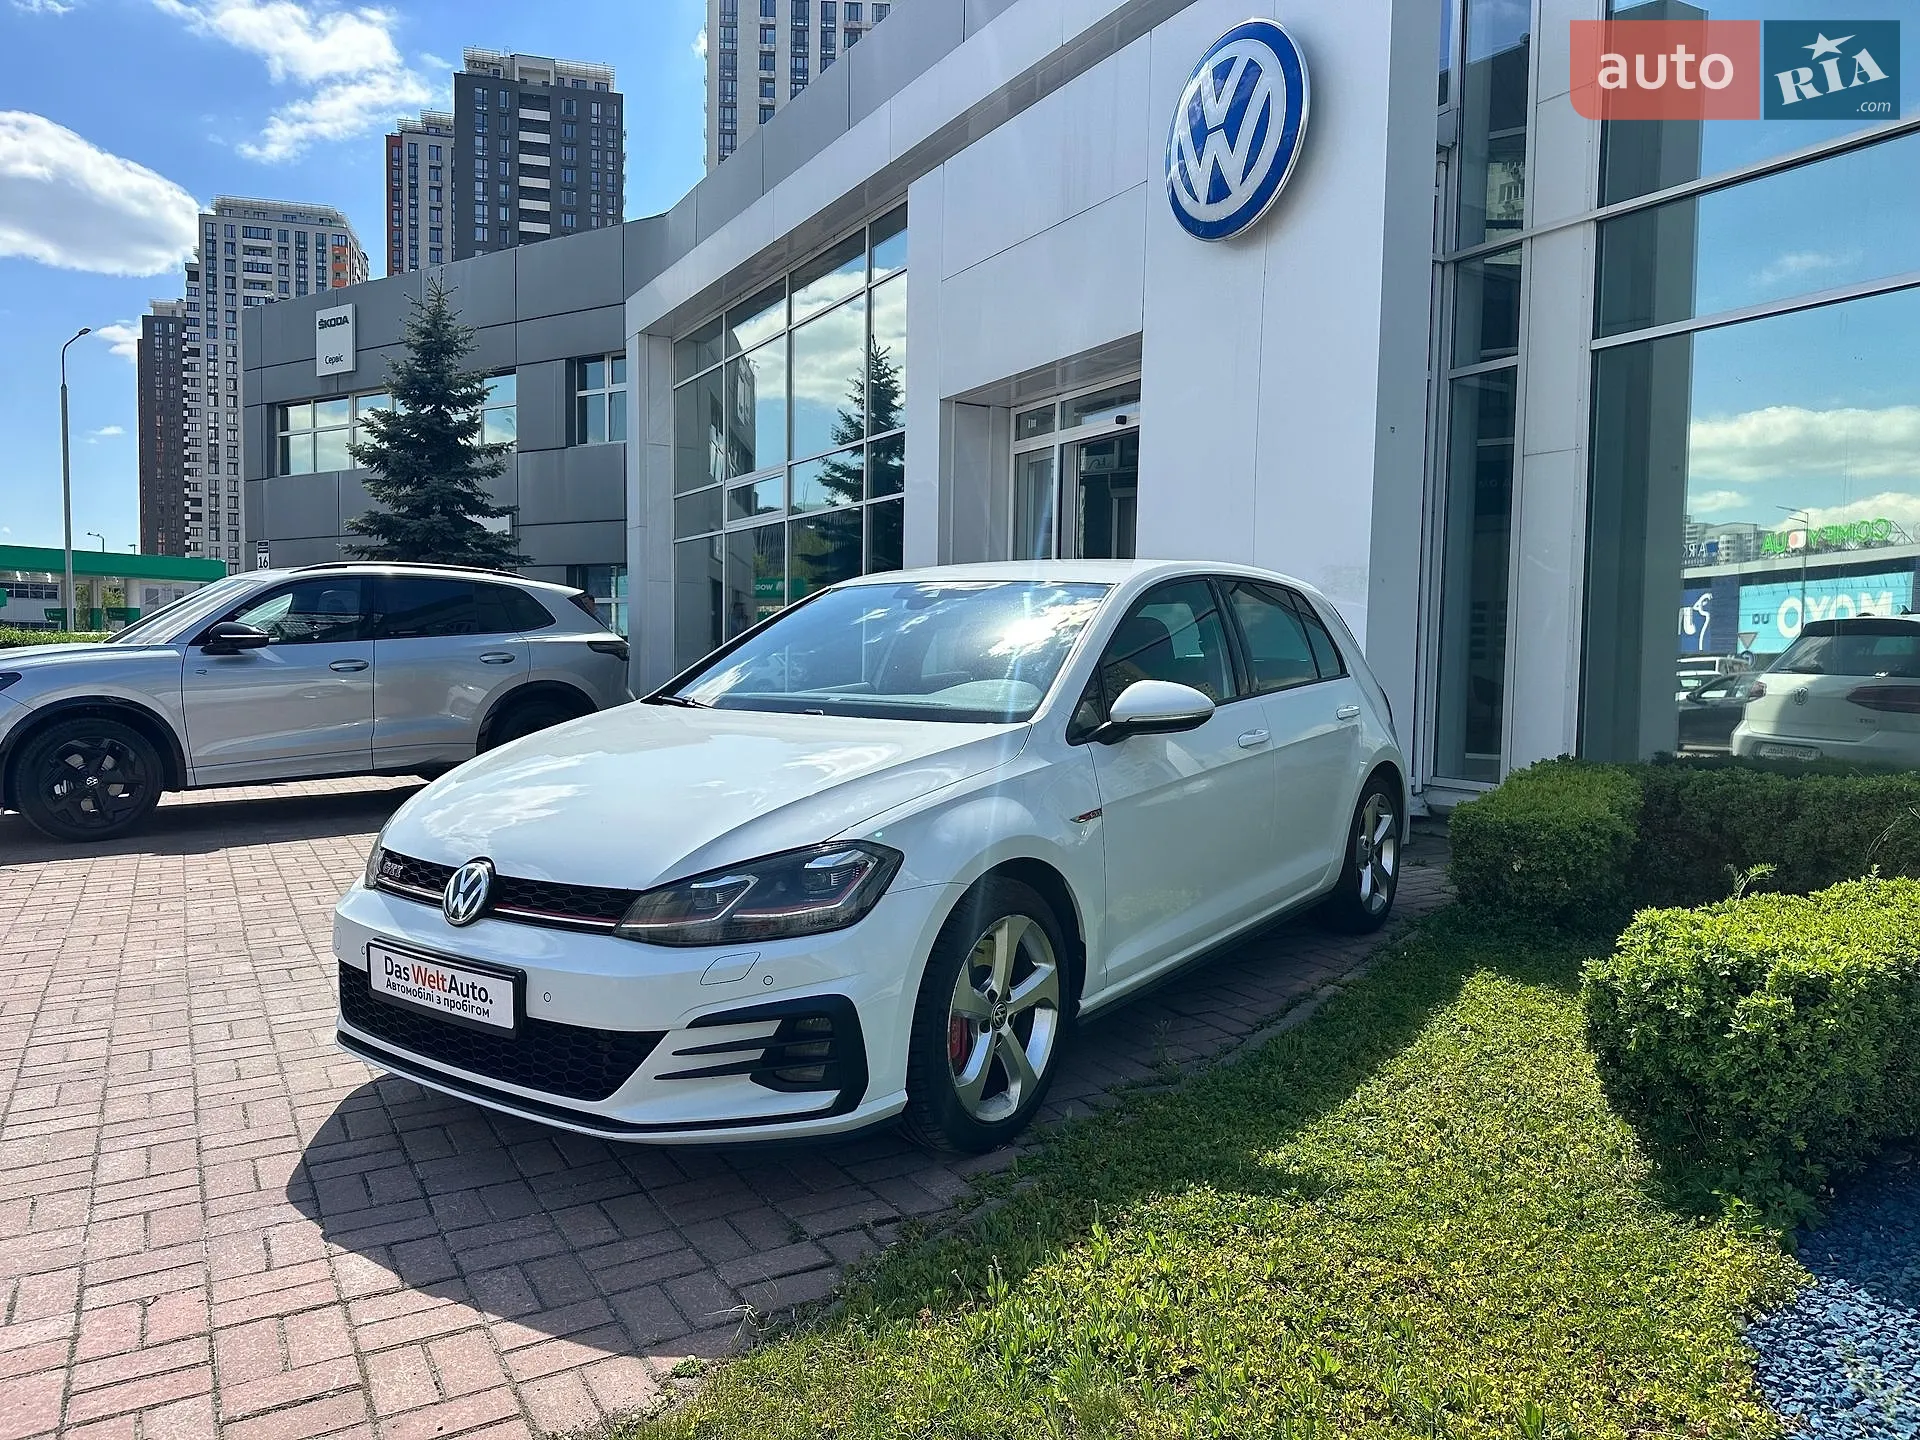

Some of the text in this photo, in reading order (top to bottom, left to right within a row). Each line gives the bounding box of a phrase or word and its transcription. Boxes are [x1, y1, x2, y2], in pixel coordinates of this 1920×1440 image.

[318, 315, 350, 330] ŠKODA
[258, 556, 269, 569] 16
[386, 977, 490, 1018] Автомобілі з пробігом
